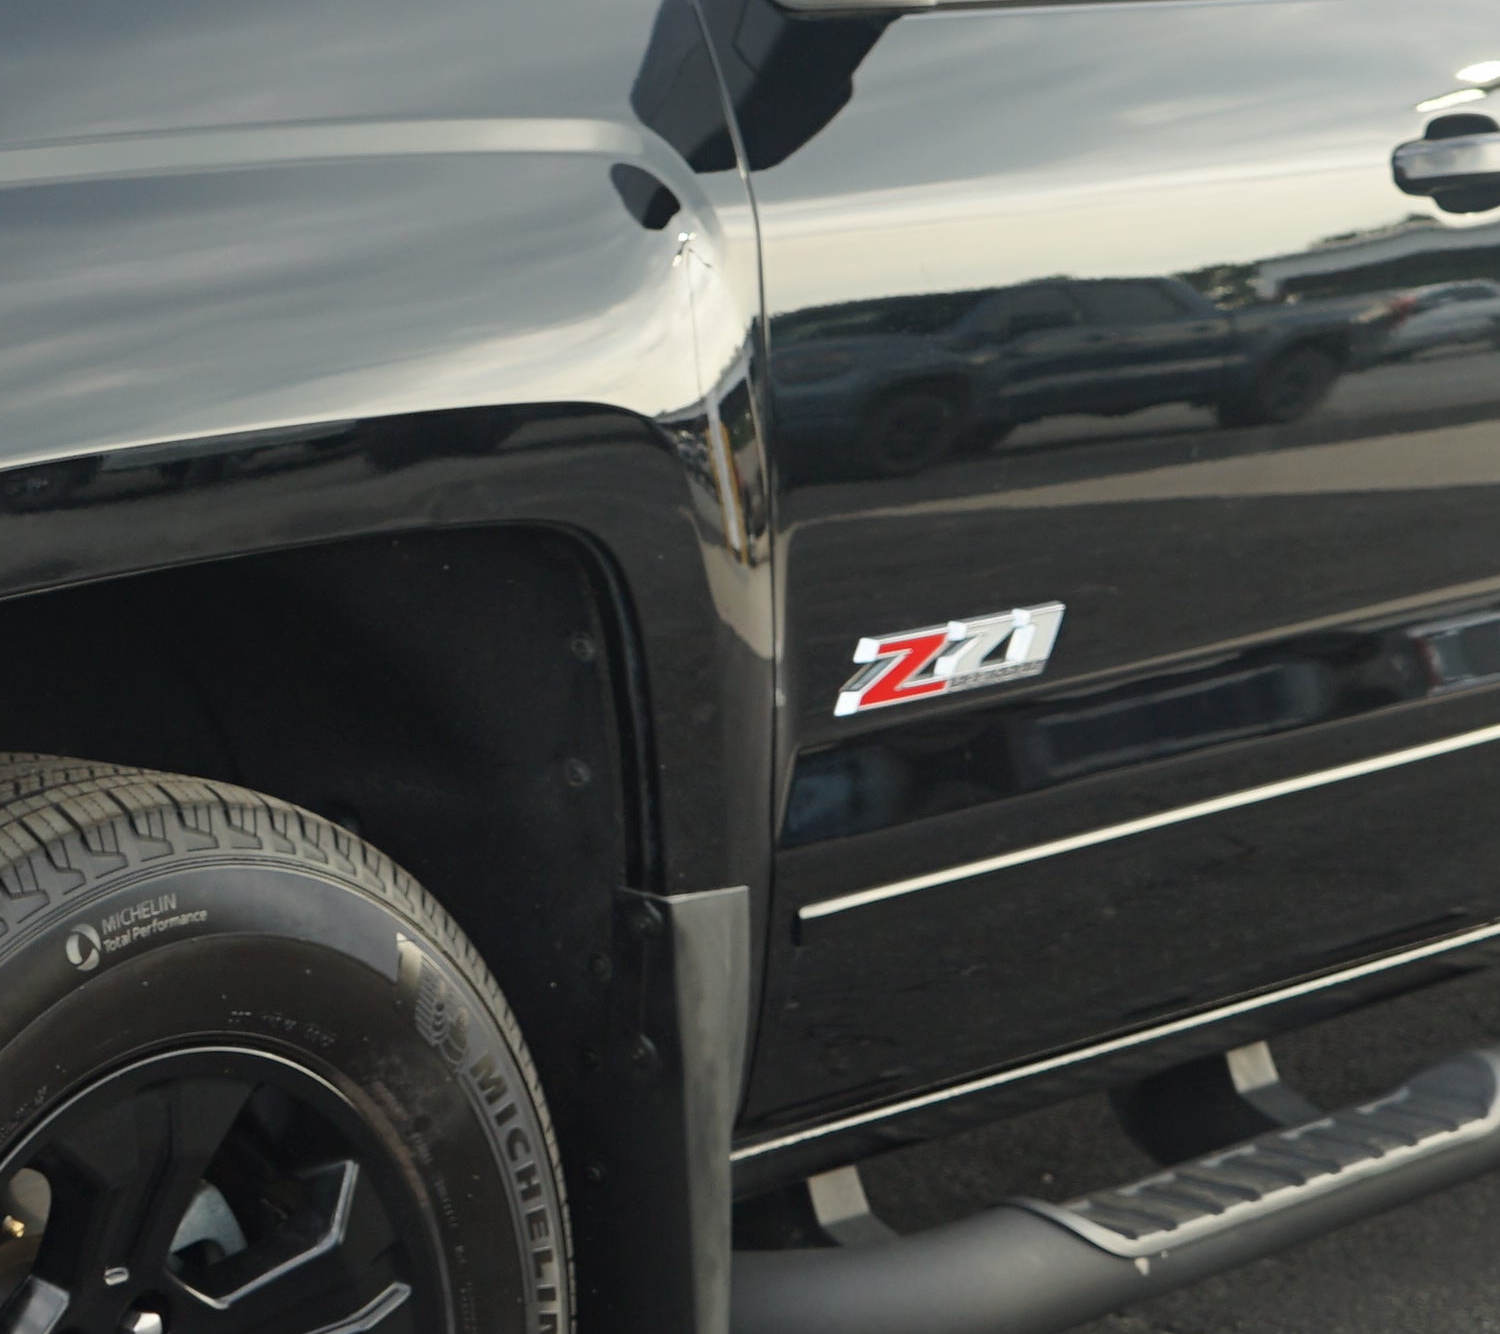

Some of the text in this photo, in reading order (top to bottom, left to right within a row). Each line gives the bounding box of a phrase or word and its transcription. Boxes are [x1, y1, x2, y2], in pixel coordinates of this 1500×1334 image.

[833, 600, 1066, 717] Z71
[102, 893, 177, 934] MICHELIN
[103, 909, 208, 953] Total Performance
